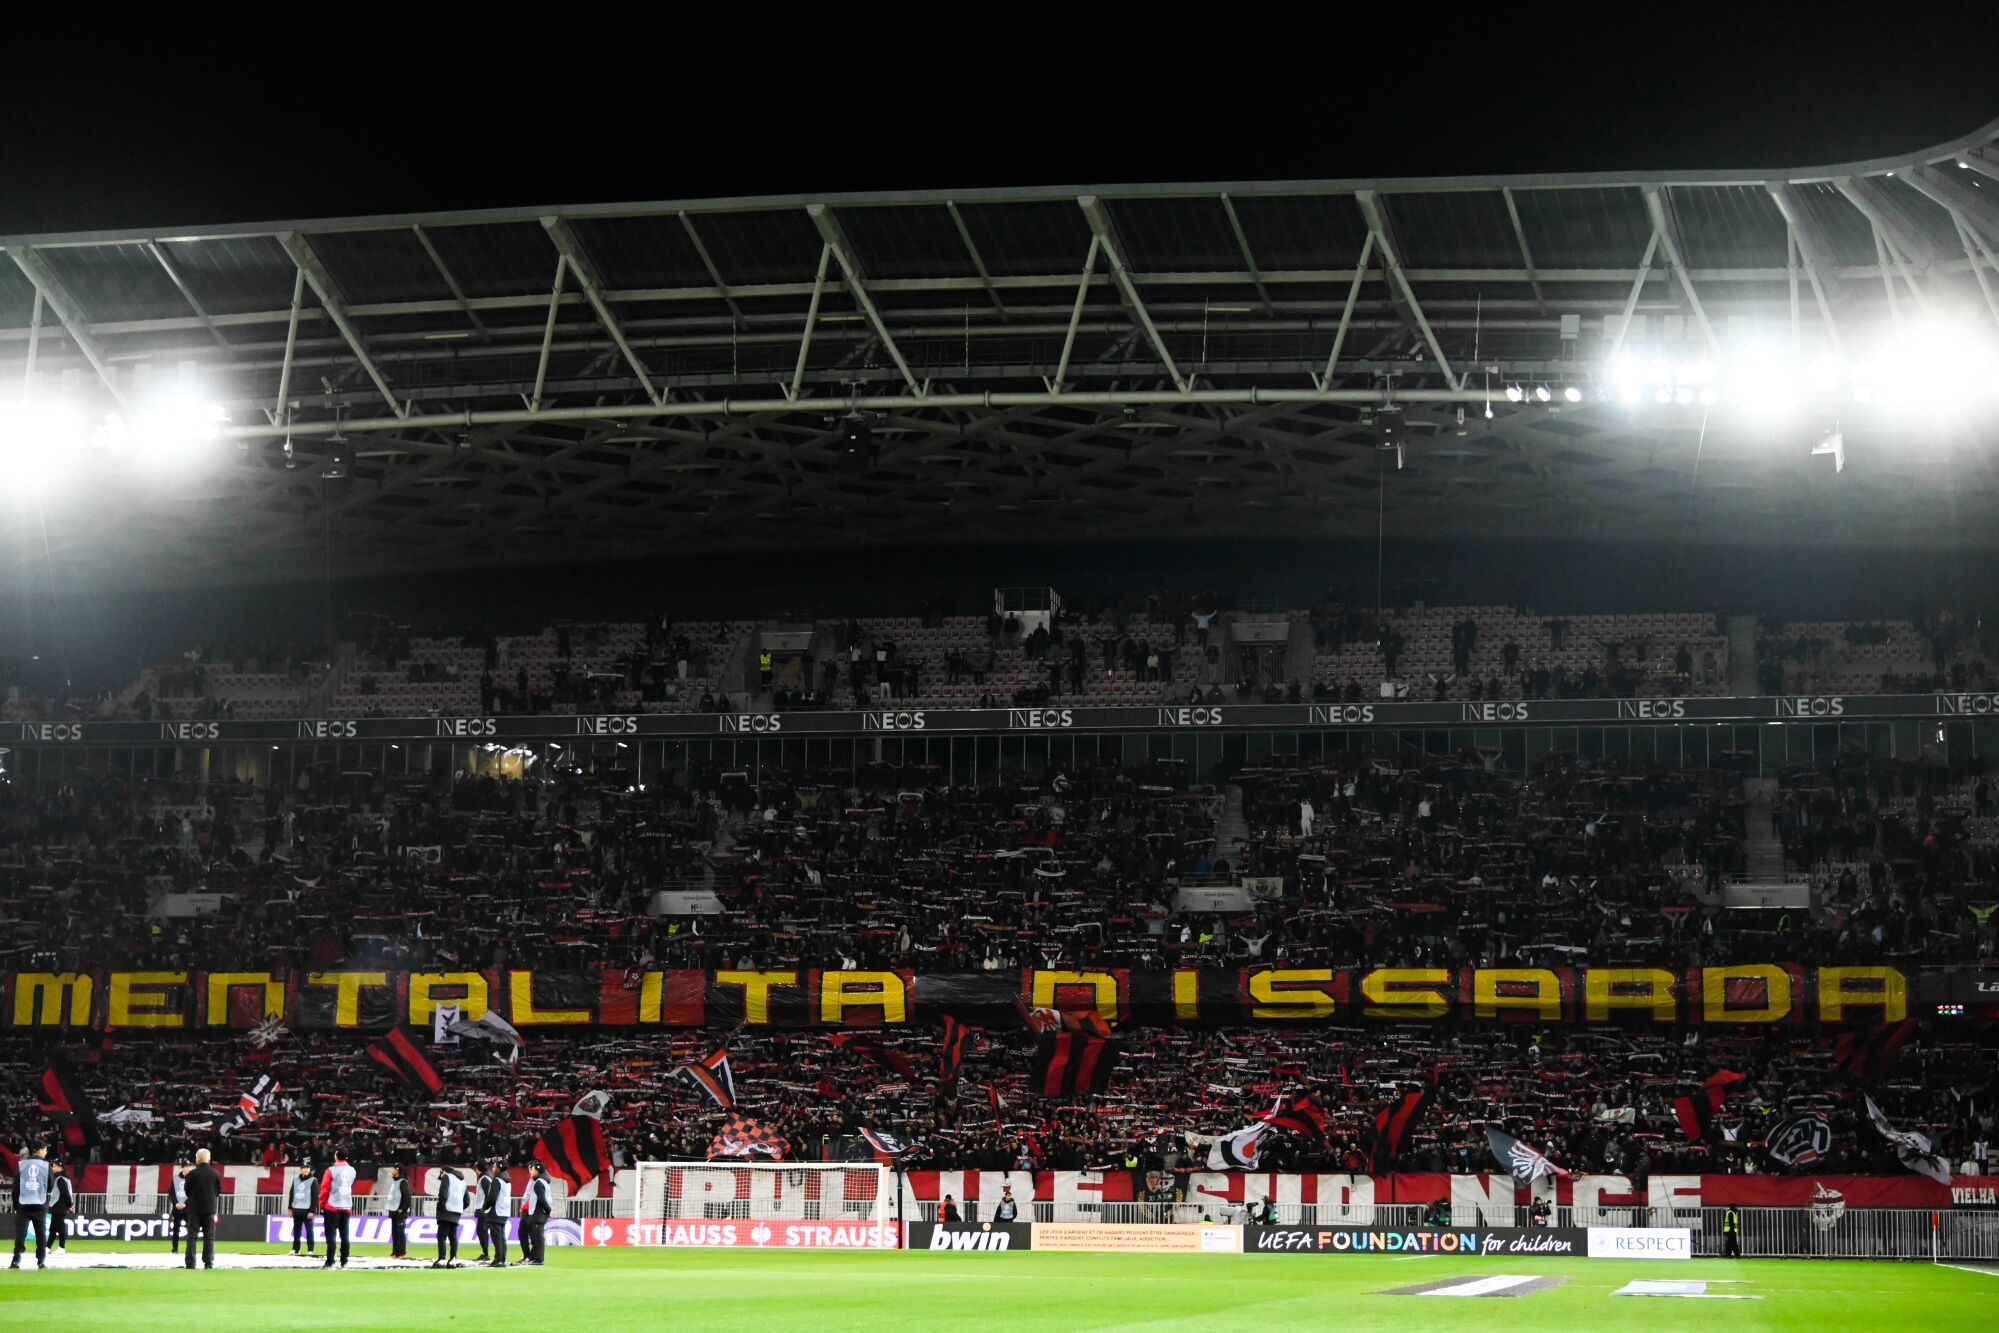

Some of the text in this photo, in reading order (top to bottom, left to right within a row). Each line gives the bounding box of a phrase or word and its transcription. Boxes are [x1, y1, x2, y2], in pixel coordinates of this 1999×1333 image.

[1158, 706, 1223, 725] INEOS
[1308, 704, 1374, 723] INEOS
[1461, 702, 1528, 721] INEOS
[1617, 699, 1686, 719] INEOS
[1775, 696, 1844, 717] INEOS
[436, 718, 496, 736] INEOS
[576, 714, 638, 734] INEOS
[719, 713, 781, 732] INEOS
[861, 711, 925, 730] INEOS
[1008, 708, 1073, 728] INEOS
[21, 724, 82, 741] INEOS
[160, 723, 219, 740] INEOS
[297, 720, 357, 738] INEOS
[13, 964, 1907, 1027] MENTALITA NISSARDA
[1183, 1171, 1375, 1226] SUD
[1450, 1173, 1702, 1228] NICE
[1951, 1187, 1996, 1204] VIELHA
[27, 1213, 204, 1241] nterpris
[627, 1225, 737, 1246] STRAUSS
[786, 1225, 897, 1246] STRAUSS
[929, 1222, 1010, 1250] bwin
[1258, 1231, 1571, 1256] UEFA FOUNDATION for children
[1616, 1236, 1686, 1251] RESPECT
